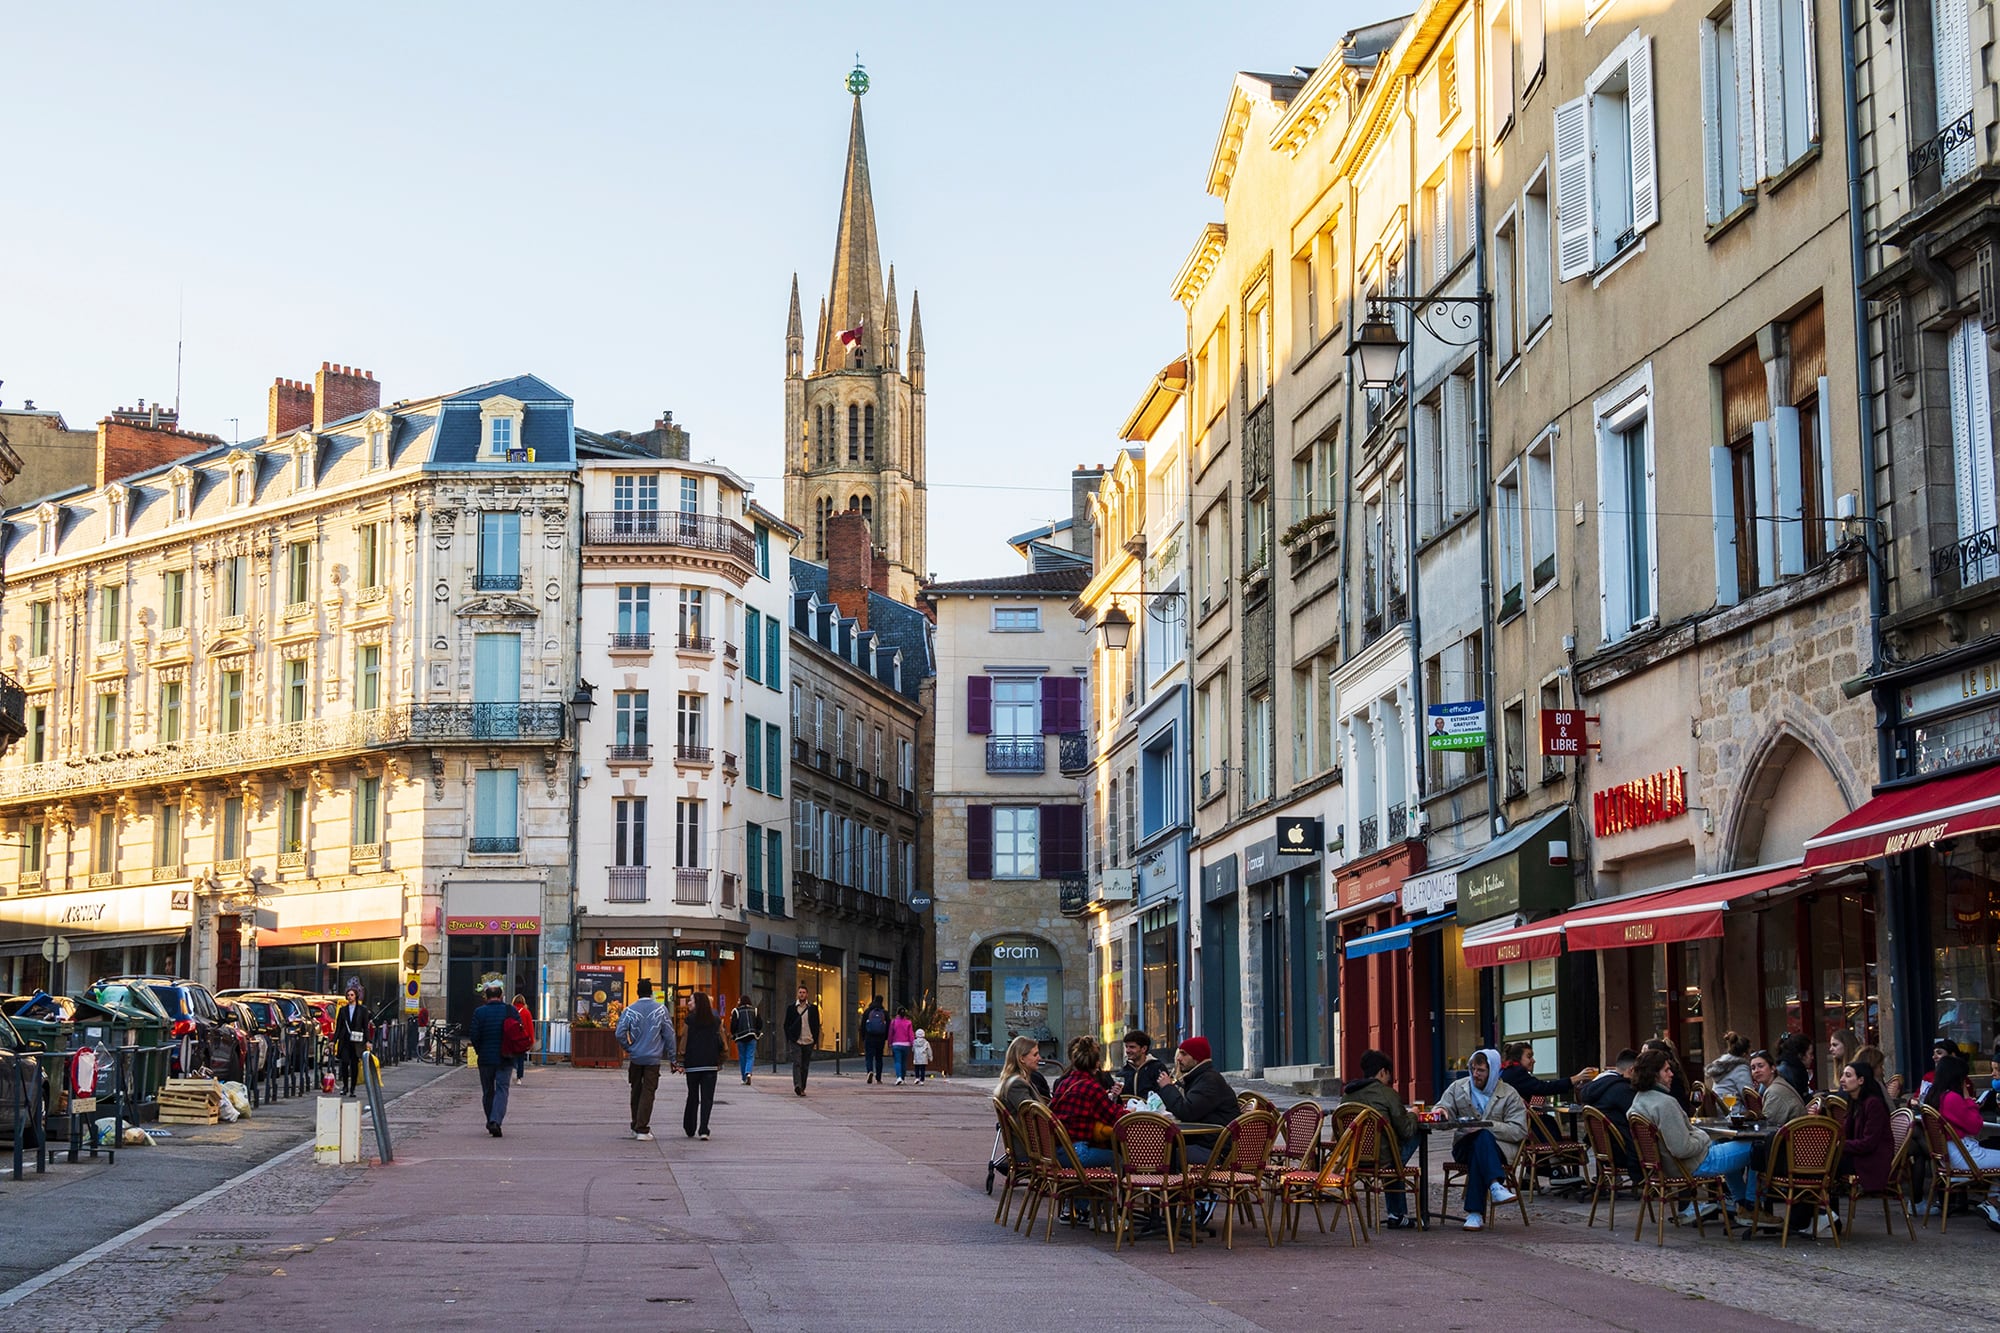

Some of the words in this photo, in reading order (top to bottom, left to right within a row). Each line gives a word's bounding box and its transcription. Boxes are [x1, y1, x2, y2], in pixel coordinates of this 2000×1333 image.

[1962, 670, 1978, 698] LE
[1449, 706, 1472, 714] efficity
[1450, 715, 1480, 723] ESTIMATION
[1555, 712, 1571, 726] BIO
[1560, 726, 1568, 738] &
[1432, 739, 1441, 747] 06
[1442, 738, 1452, 746] 22
[1453, 737, 1462, 745] 09
[1463, 736, 1473, 744] 37
[1474, 735, 1484, 743] 37
[1550, 738, 1578, 752] LIBRE
[1593, 765, 1686, 838] NATURALIA
[1884, 832, 1908, 856] MADE
[1904, 830, 1917, 851] IN
[1912, 822, 1949, 848] LIMOGES
[912, 896, 931, 905] éram
[1624, 923, 1654, 941] NATURALIA
[605, 945, 660, 957] E-CIGARETTES
[993, 941, 1039, 959] éram
[1497, 943, 1521, 961] NATURALIA
[1013, 1009, 1040, 1017] TEXTO
